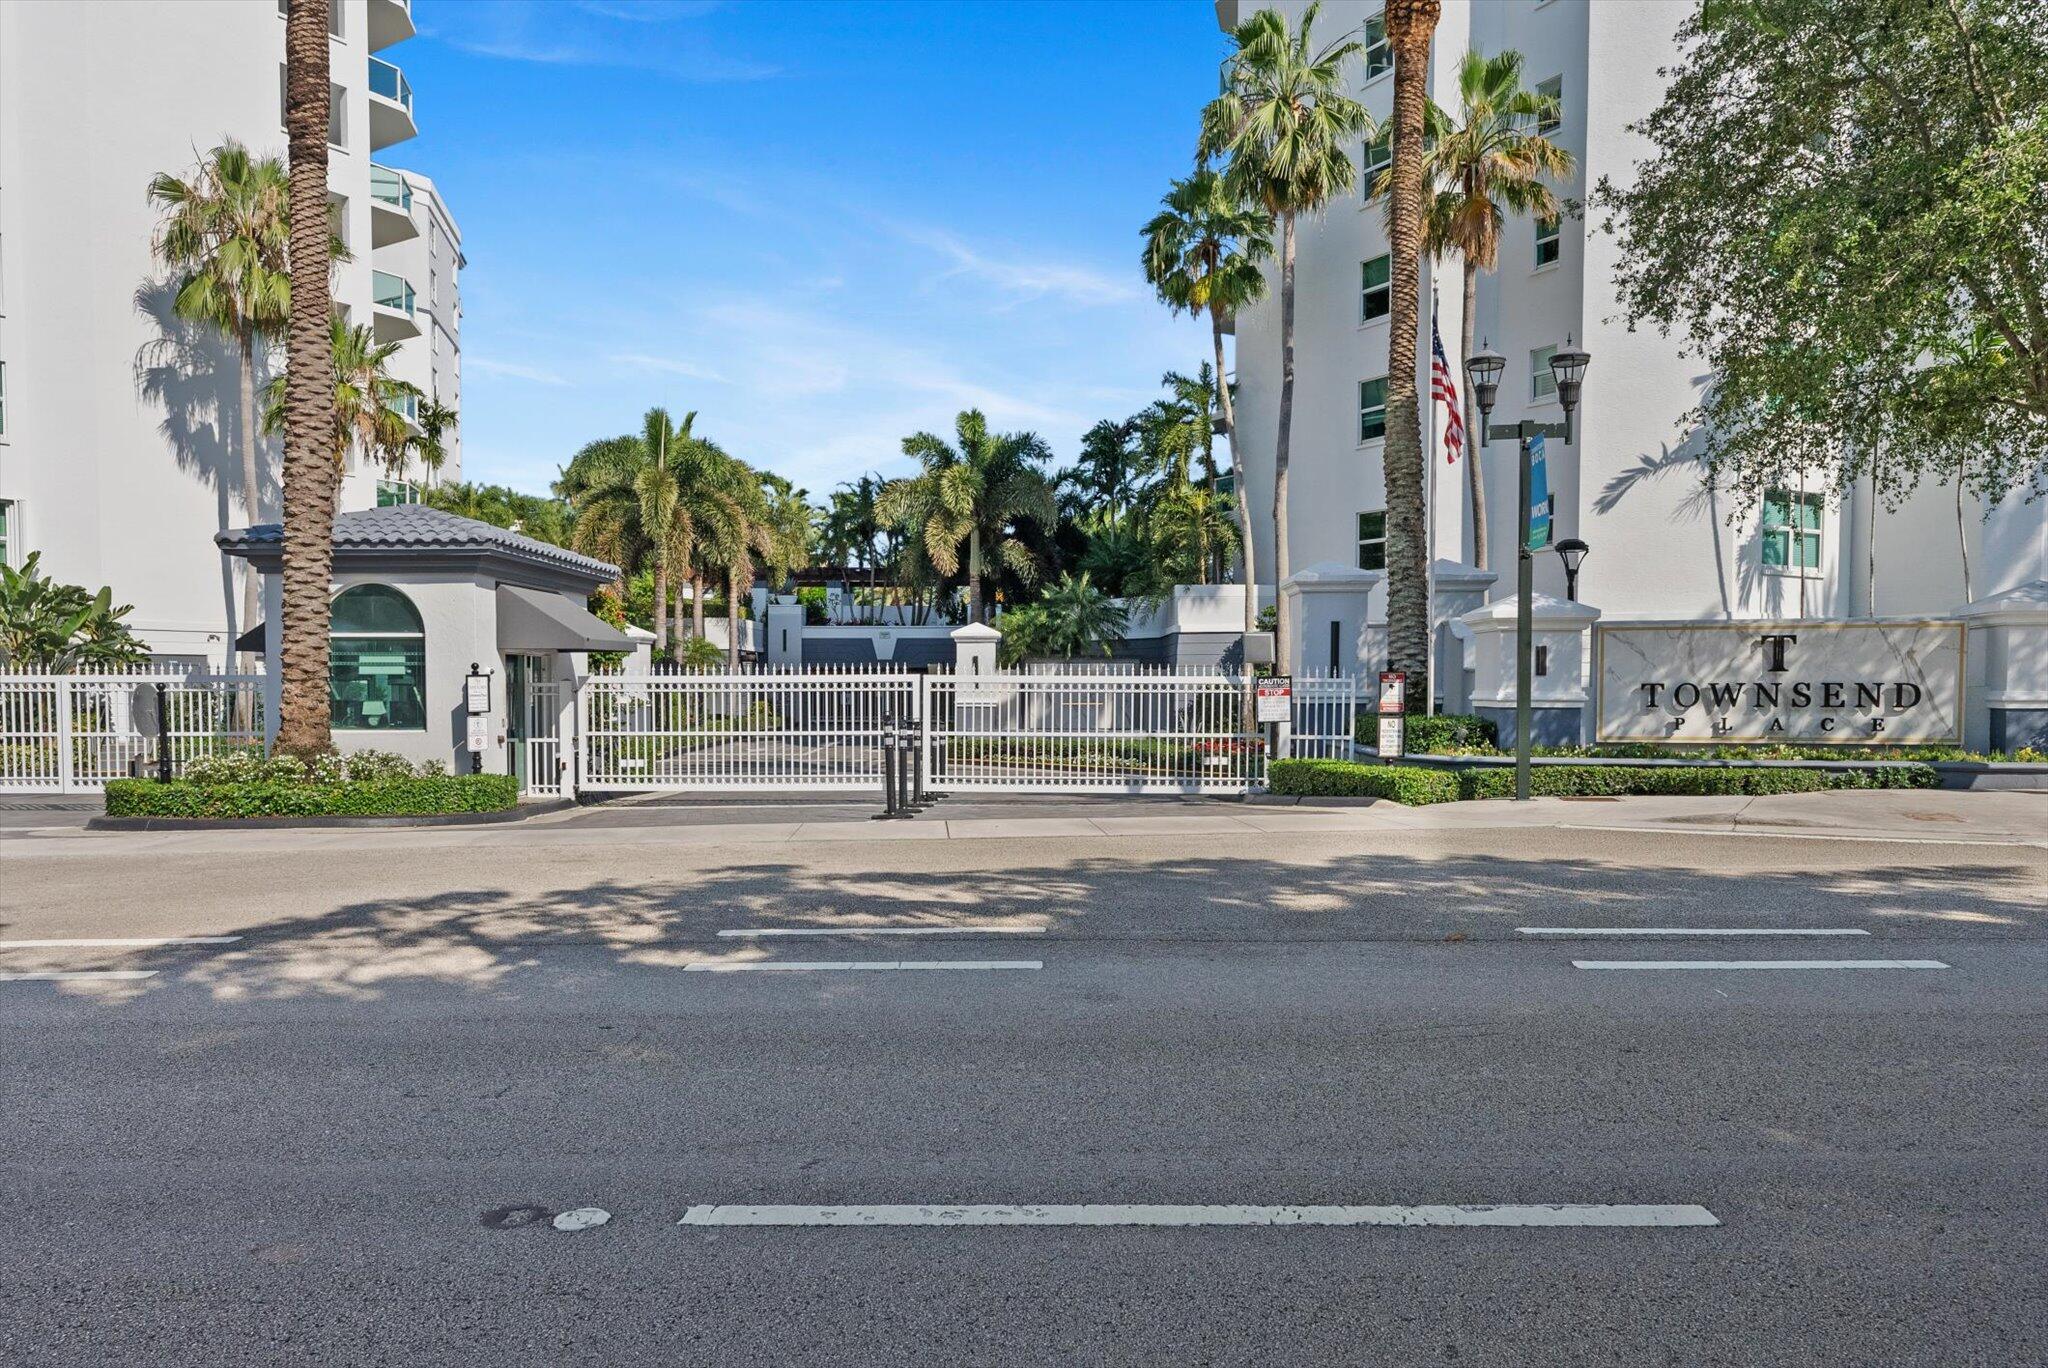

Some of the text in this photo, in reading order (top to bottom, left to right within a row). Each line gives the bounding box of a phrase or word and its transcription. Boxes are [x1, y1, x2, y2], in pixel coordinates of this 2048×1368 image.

[1761, 634, 1797, 672] T
[1641, 682, 1922, 708] TOWNSEND
[1387, 720, 1396, 729] NO
[1674, 717, 1885, 732] PLACE
